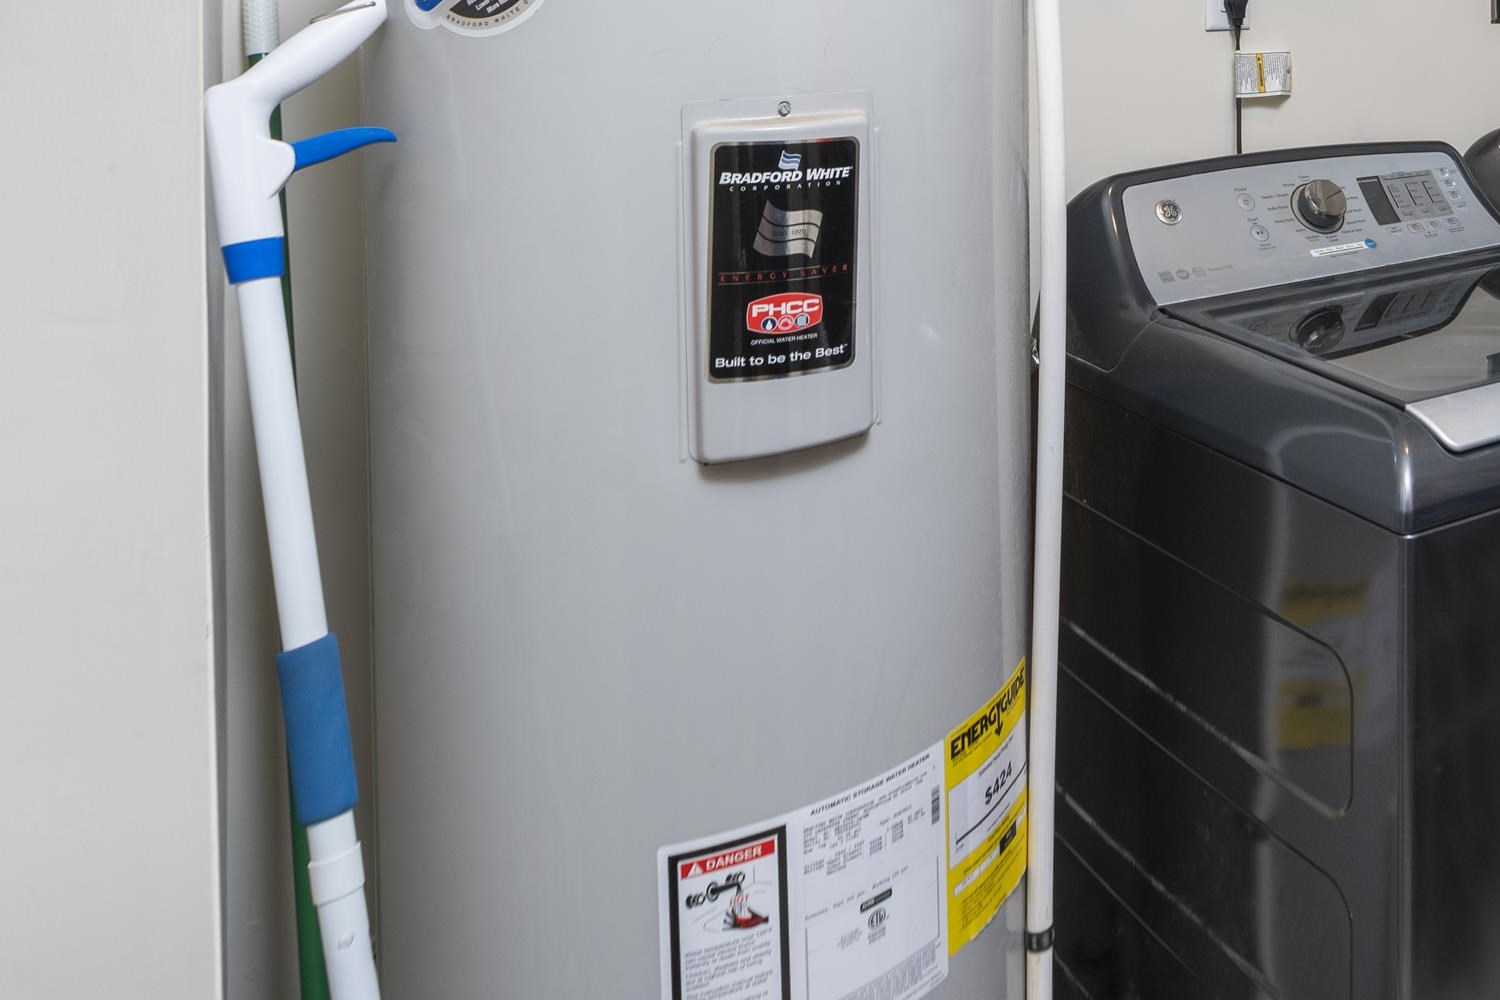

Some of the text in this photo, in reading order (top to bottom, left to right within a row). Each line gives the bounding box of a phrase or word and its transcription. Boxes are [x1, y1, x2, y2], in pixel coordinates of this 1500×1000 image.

[446, 14, 489, 28] BRADFORD
[494, 6, 521, 23] WHITE
[719, 166, 851, 185] BRADFORD WHITE
[729, 180, 841, 192] CORPORATION
[719, 264, 849, 283] ENERGY SAVER
[751, 298, 820, 317] PHCC
[750, 333, 818, 346] OFFICIAL WATER HEATER
[715, 344, 844, 369] Built to be the Best
[810, 753, 930, 816] AUTOMATIC STORAGE WATER HEATER
[985, 760, 1012, 805] $424
[705, 845, 762, 871] DANGER
